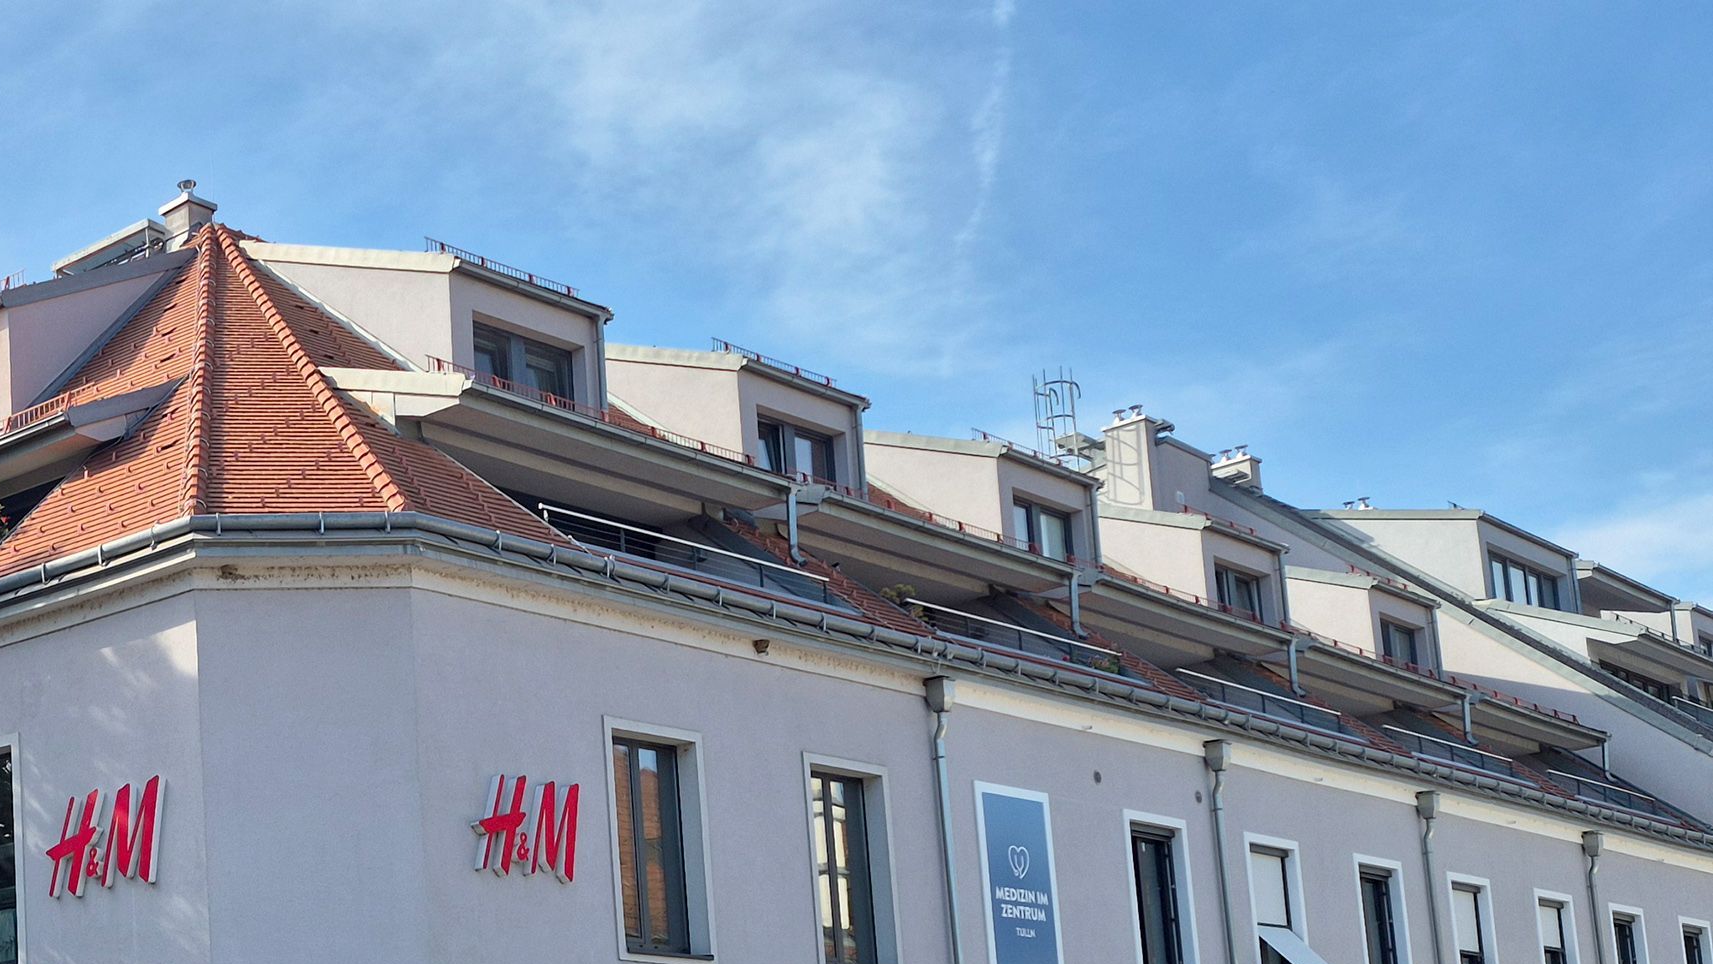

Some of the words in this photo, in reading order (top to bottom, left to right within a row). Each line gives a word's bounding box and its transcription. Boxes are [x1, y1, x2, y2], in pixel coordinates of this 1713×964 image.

[45, 774, 165, 898] H&M
[471, 773, 579, 884] H&M
[995, 886, 1036, 904] MEDIZIN
[1037, 891, 1049, 906] IM
[1000, 904, 1047, 922] ZENTRUM
